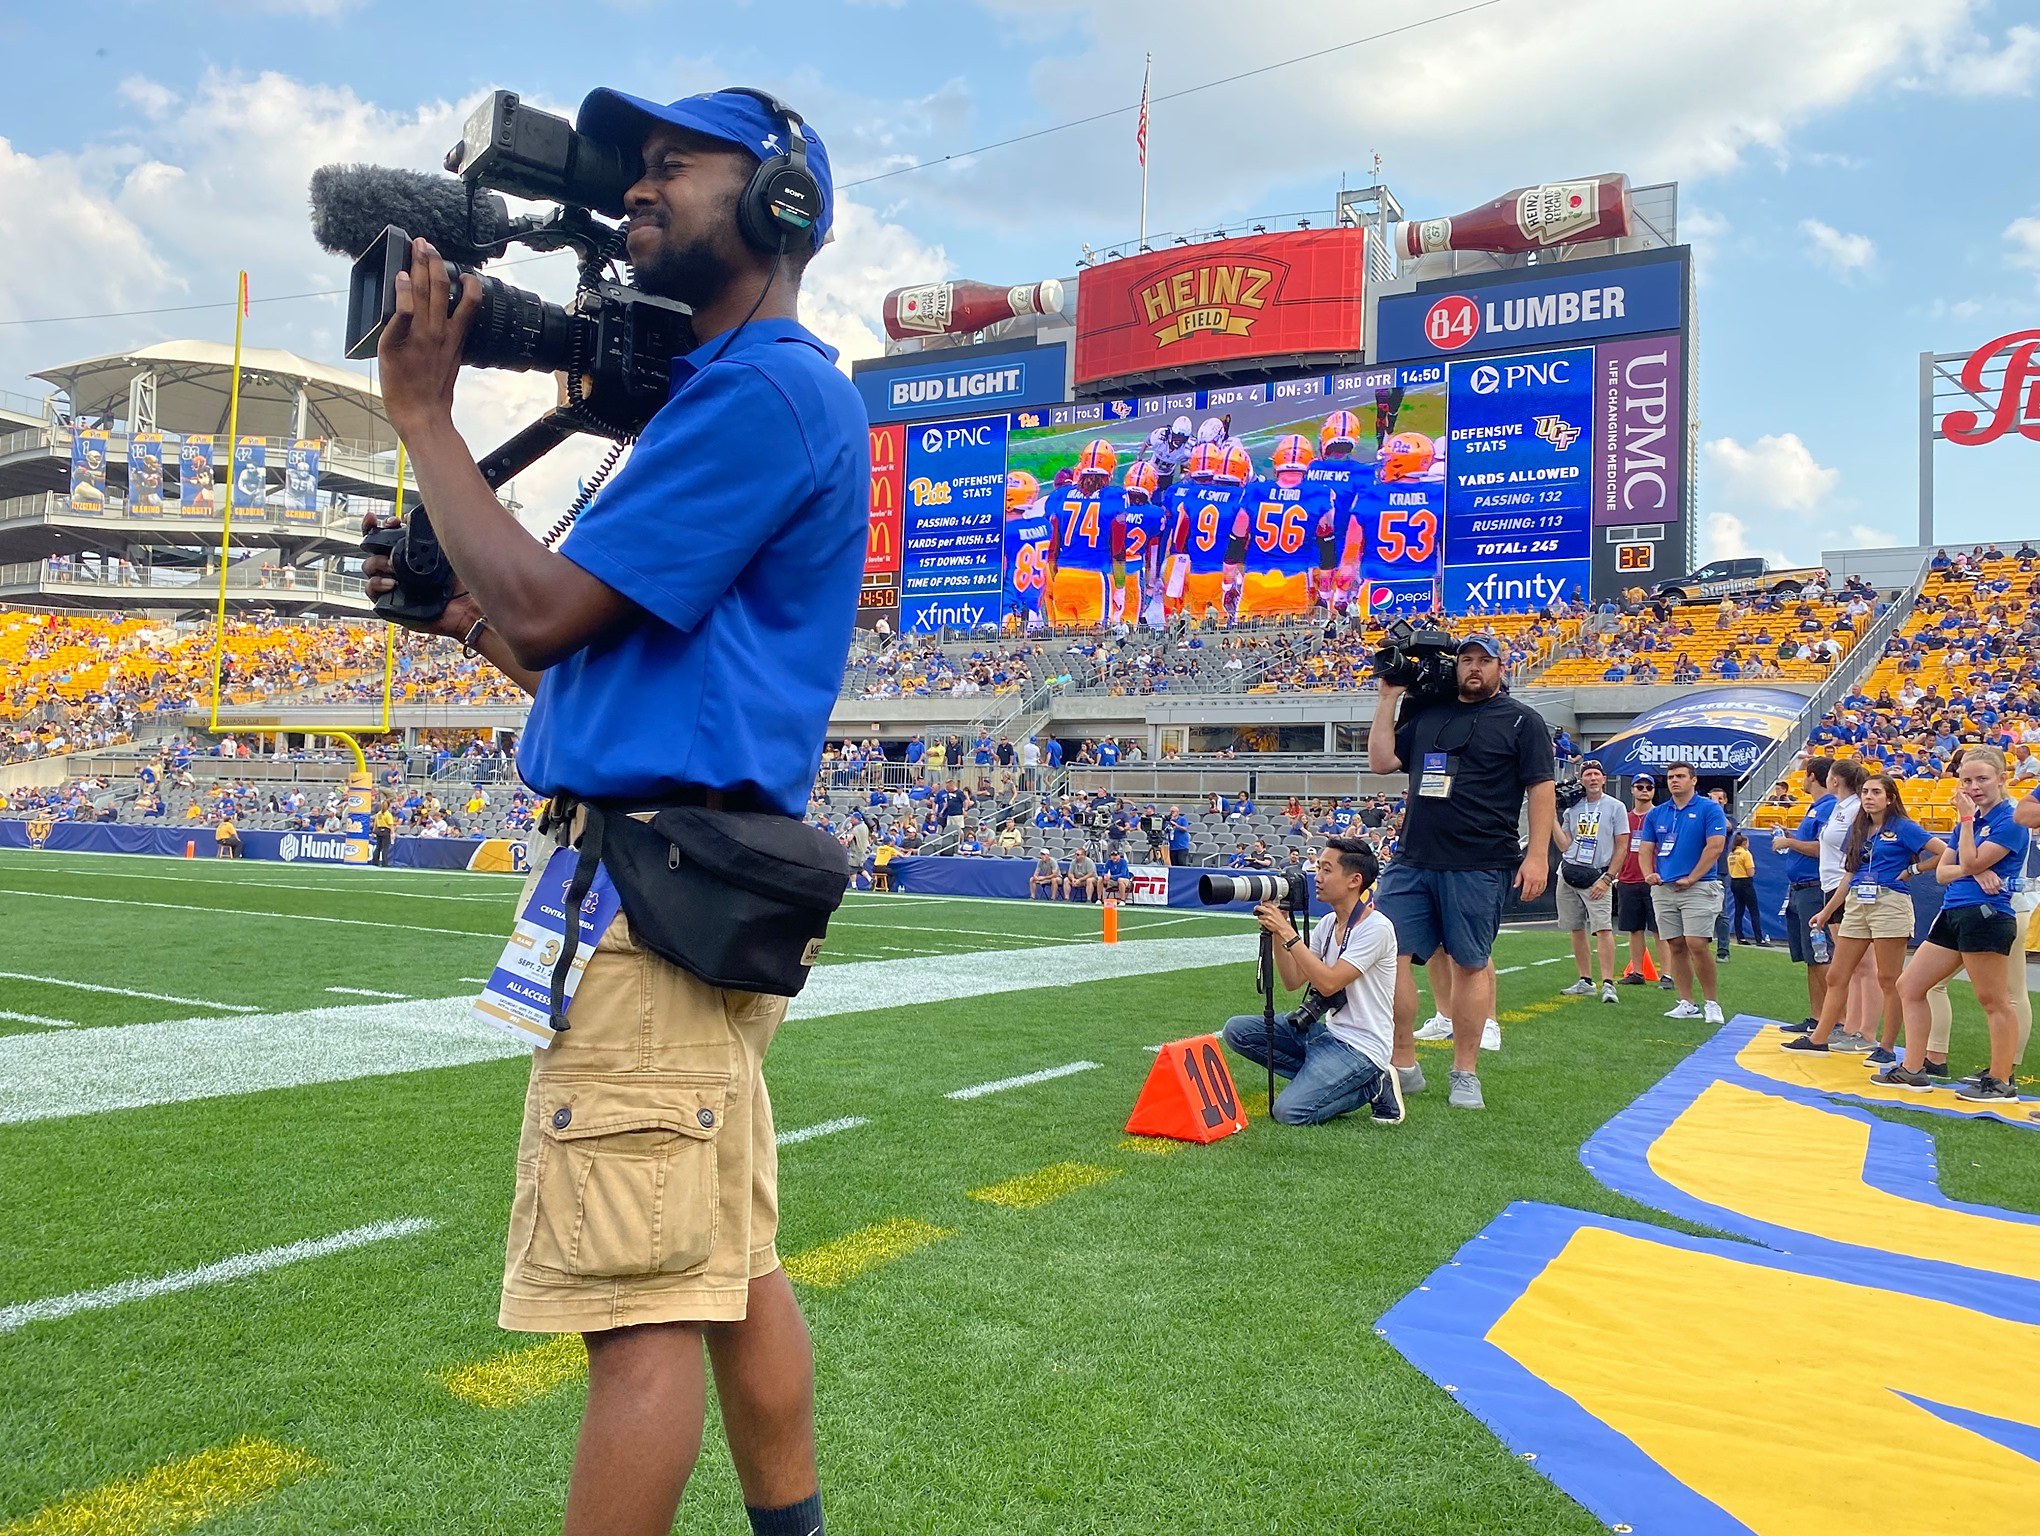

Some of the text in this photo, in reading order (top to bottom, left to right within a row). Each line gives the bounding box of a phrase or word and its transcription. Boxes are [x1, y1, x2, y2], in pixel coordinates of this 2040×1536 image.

[784, 187, 805, 200] SONY
[1141, 265, 1272, 325] HEINZ
[1185, 311, 1222, 330] FIELD
[1431, 286, 1625, 340] 84 LUMBER
[1337, 373, 1391, 390] 3RD QTR
[1401, 367, 1440, 384] 14:50
[1504, 361, 1570, 389] PNC
[893, 369, 1020, 405] BUD LIGHT
[1276, 381, 1319, 398] ON: 31
[1166, 397, 1193, 409] TOL 3
[1211, 392, 1235, 406] 2ND
[1249, 389, 1258, 401] 4
[1076, 407, 1100, 419] TOL 3
[1144, 400, 1159, 413] 10
[1055, 410, 1068, 423] 21
[945, 426, 991, 448] PNC
[1451, 424, 1523, 441] DEFENSIVE
[1532, 415, 1581, 451] UCF
[1606, 359, 1619, 511] LIFE CHANGING MEDICINE
[1623, 350, 1668, 511] UPMC
[131, 444, 147, 458] 13
[181, 446, 200, 460] 33
[235, 447, 252, 461] 42
[1465, 440, 1507, 454] STATS
[952, 474, 1003, 487] OFFENSIVE
[1307, 469, 1350, 482] MATHEWS
[1458, 466, 1580, 487] YARDS ALLOWED
[909, 476, 952, 506] Pitt
[962, 488, 992, 499] STATS
[1278, 489, 1301, 501] FORD
[1389, 492, 1429, 505] KRADEL
[1473, 490, 1562, 508] PASSING: 132
[285, 510, 316, 519] SCHMIDT
[916, 516, 959, 529] PASSING:
[1125, 513, 1144, 525] AVIS
[1063, 501, 1100, 547] 74
[1196, 504, 1219, 552] 9
[1255, 502, 1308, 554] 56
[1472, 515, 1563, 532] RUSHING: 113
[907, 533, 1000, 549] YARDS per RUSH: 5.4
[1125, 527, 1147, 561] 2
[1377, 509, 1438, 562] 53
[1476, 540, 1559, 556] TOTAL: 245
[919, 554, 987, 568] 1ST DOWNS: 14
[1013, 539, 1050, 592] 85
[1621, 548, 1650, 568] 32
[906, 574, 998, 588] TIME OF POSS: 18:14
[1700, 578, 1756, 598] Steelers
[858, 589, 894, 607] 14:50
[1396, 590, 1431, 604] pepsi
[1465, 573, 1567, 608] xfinity
[916, 602, 985, 631] xfinity
[1639, 745, 1733, 762] SHORKEY
[1336, 813, 1351, 825] 33
[540, 905, 594, 931] CENTRA RIDA
[540, 939, 560, 966] 3
[518, 958, 535, 970] SEPT.
[506, 981, 551, 1006] ALL ACCESS
[1184, 1043, 1238, 1129] 10
